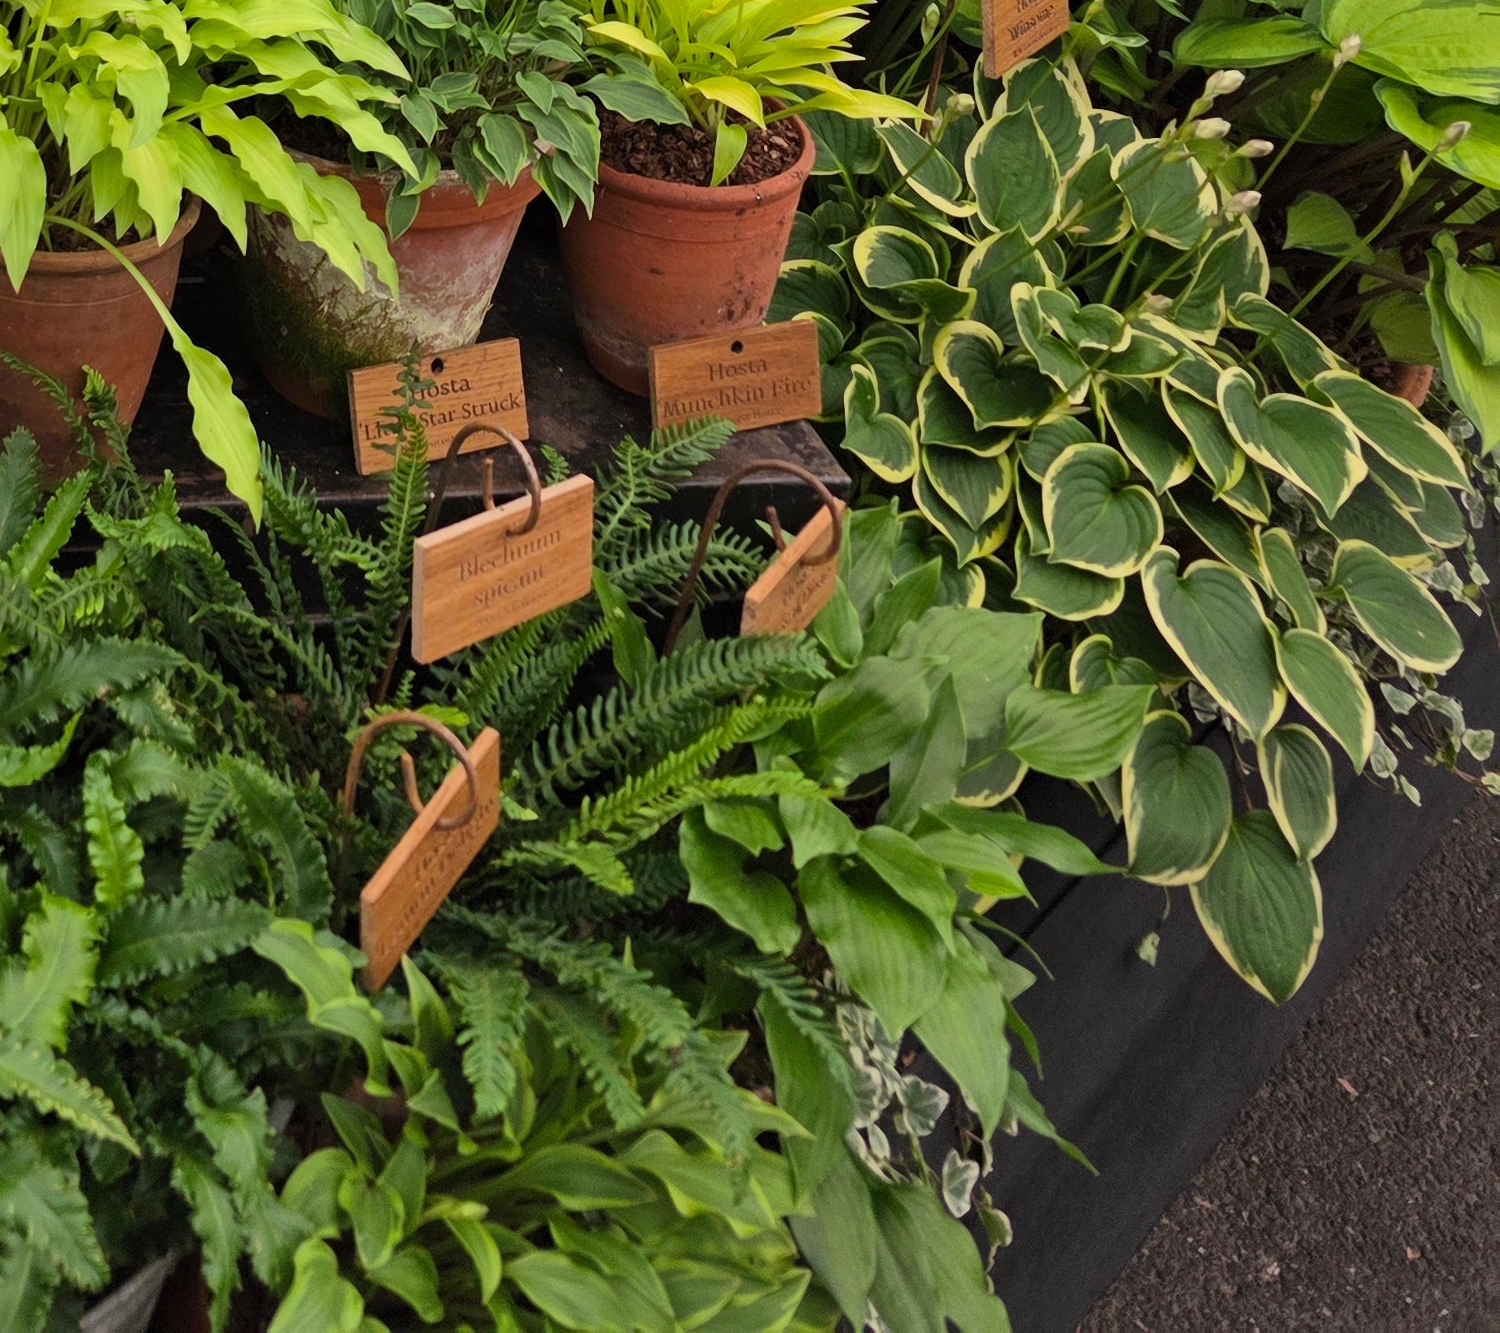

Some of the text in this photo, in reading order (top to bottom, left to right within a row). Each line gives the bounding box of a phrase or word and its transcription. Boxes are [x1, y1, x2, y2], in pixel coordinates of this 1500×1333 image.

[708, 359, 767, 381] Hosta
[419, 389, 524, 429] Star Struck'
[459, 529, 562, 581] Blechnum
